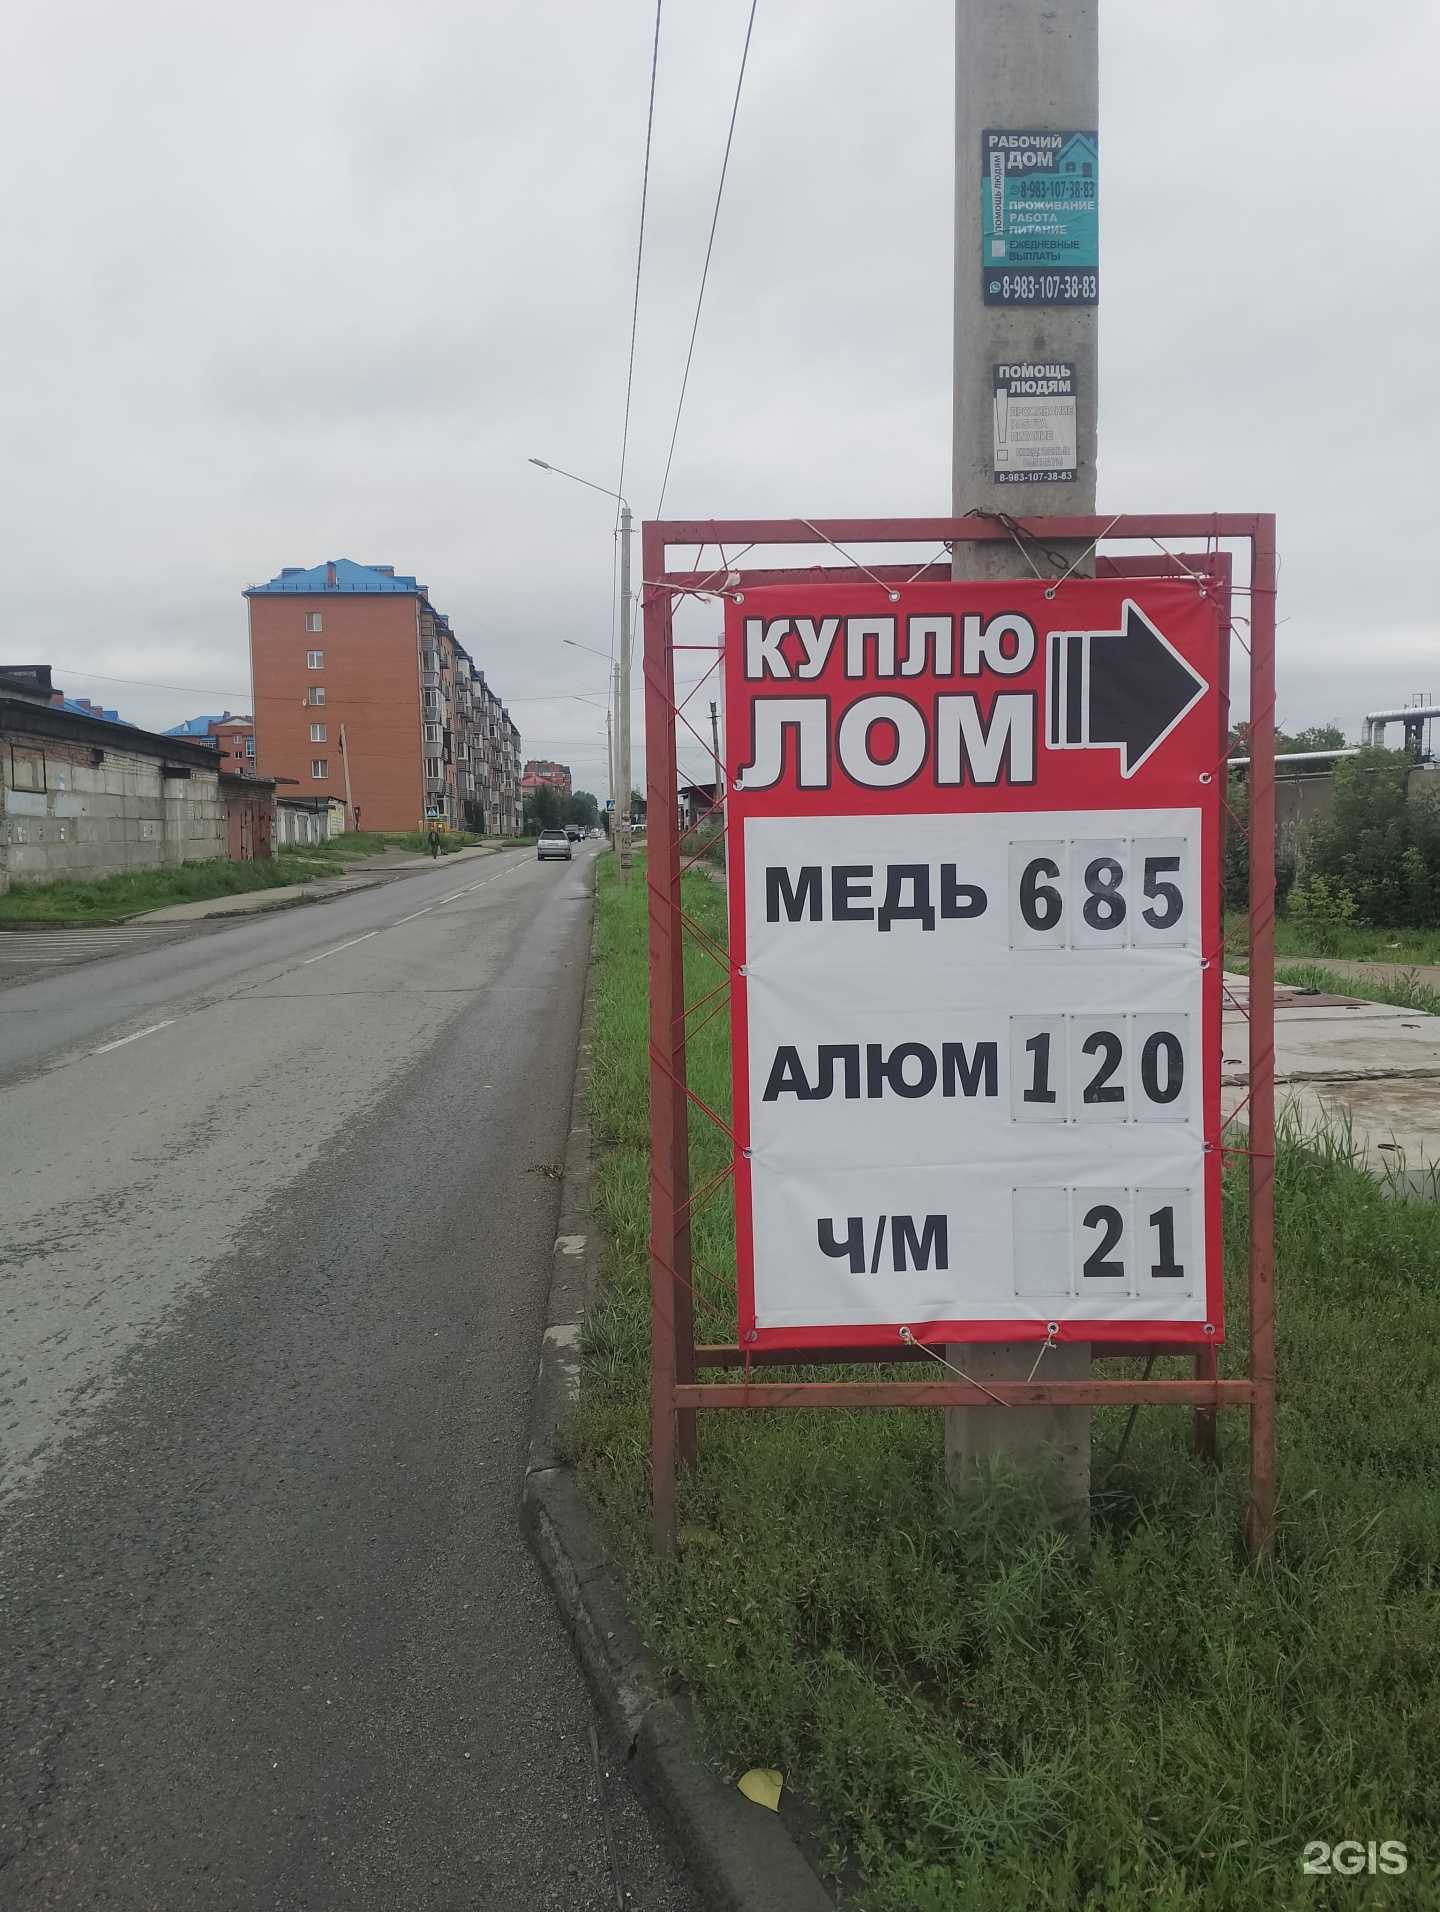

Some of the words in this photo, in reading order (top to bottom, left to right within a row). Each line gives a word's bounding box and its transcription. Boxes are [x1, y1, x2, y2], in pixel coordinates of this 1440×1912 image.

[989, 134, 1062, 149] РАБОЧИЙ
[1007, 151, 1053, 169] ДОМ
[1008, 200, 1096, 211] ПРОЖИВАНИЕ
[1009, 212, 1058, 223] РАБОТА
[1008, 224, 1068, 235] ПИТАНИЕ
[1009, 240, 1080, 250] ЕЖЕДНЕВНЫЕ
[1009, 251, 1061, 261] ВЫПЛАТЫ
[1002, 275, 1097, 299] 8-983-107-38-83
[999, 364, 1071, 379] ПОМОЩЬ
[1009, 380, 1071, 395] ЛЮДЯМ
[744, 612, 1037, 679] КУПЛЮ
[740, 692, 1036, 788] ЛОМ
[765, 863, 988, 932] МЕДЬ
[1019, 856, 1184, 931] 685
[762, 1042, 998, 1101] АЛЮМ
[1023, 1031, 1184, 1104] 120
[817, 1214, 949, 1274] Ч/М
[1082, 1204, 1185, 1278] 21
